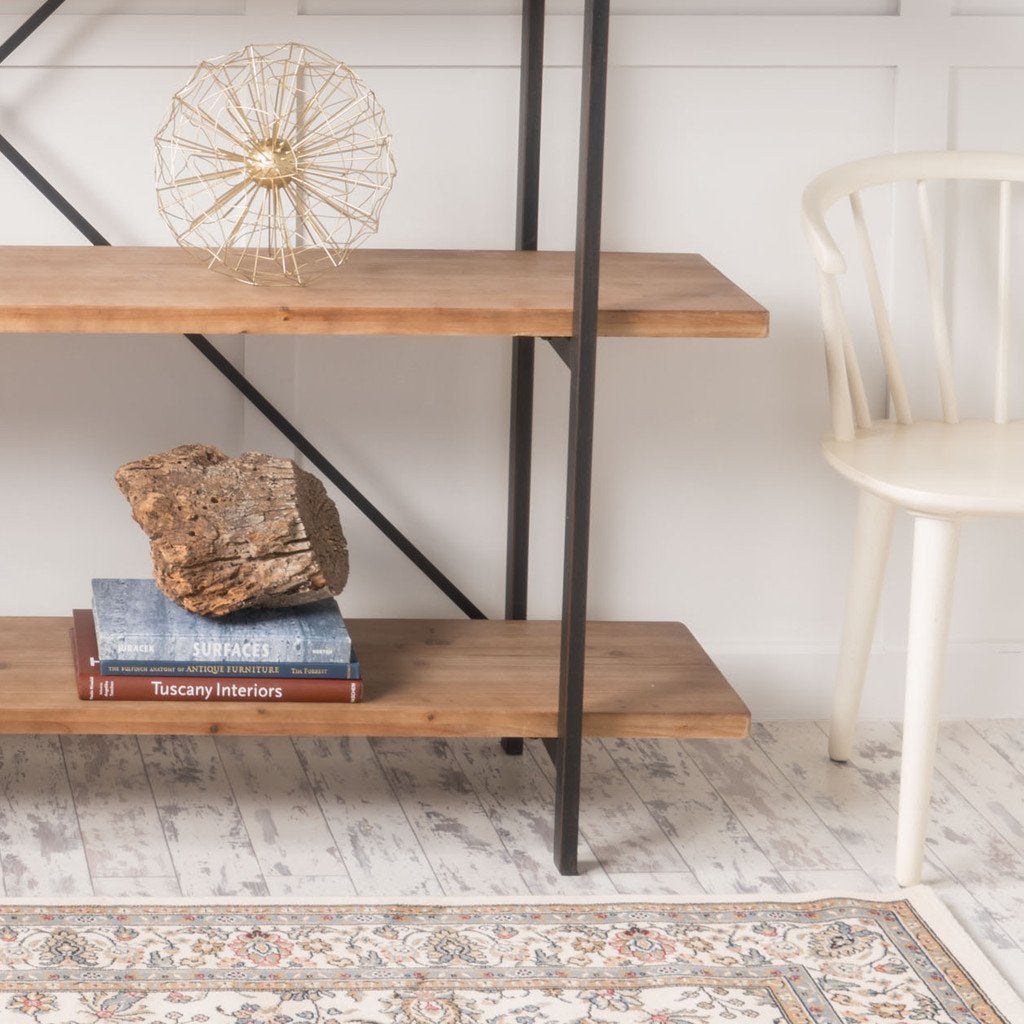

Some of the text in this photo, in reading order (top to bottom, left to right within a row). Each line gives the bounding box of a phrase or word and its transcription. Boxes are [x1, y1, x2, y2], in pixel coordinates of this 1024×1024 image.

[192, 642, 270, 658] SURFACES
[185, 665, 224, 675] ANTIQUE
[226, 666, 280, 674] FURNITURE
[151, 680, 283, 701] Tuscany Interiors
